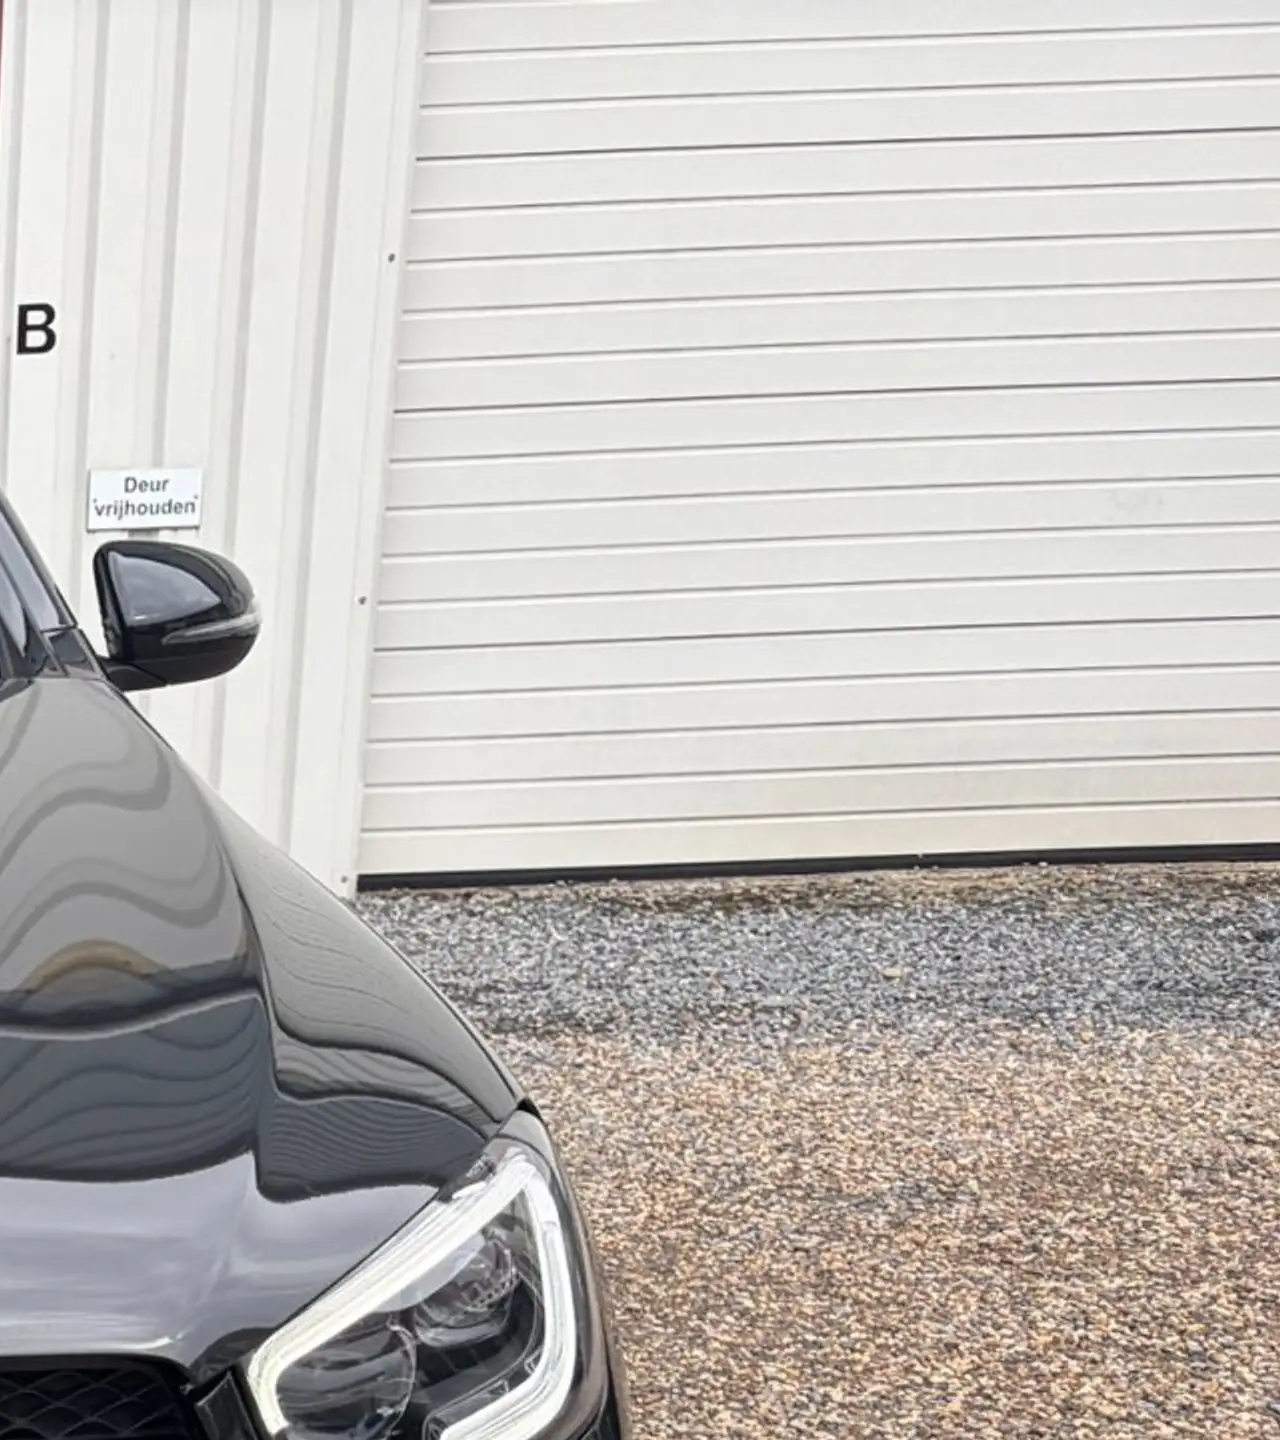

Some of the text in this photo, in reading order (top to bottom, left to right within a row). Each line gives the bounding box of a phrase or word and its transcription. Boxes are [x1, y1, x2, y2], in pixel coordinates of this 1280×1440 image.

[16, 302, 57, 355] B
[124, 476, 170, 493] Deur
[94, 498, 196, 521] vrijhouden
